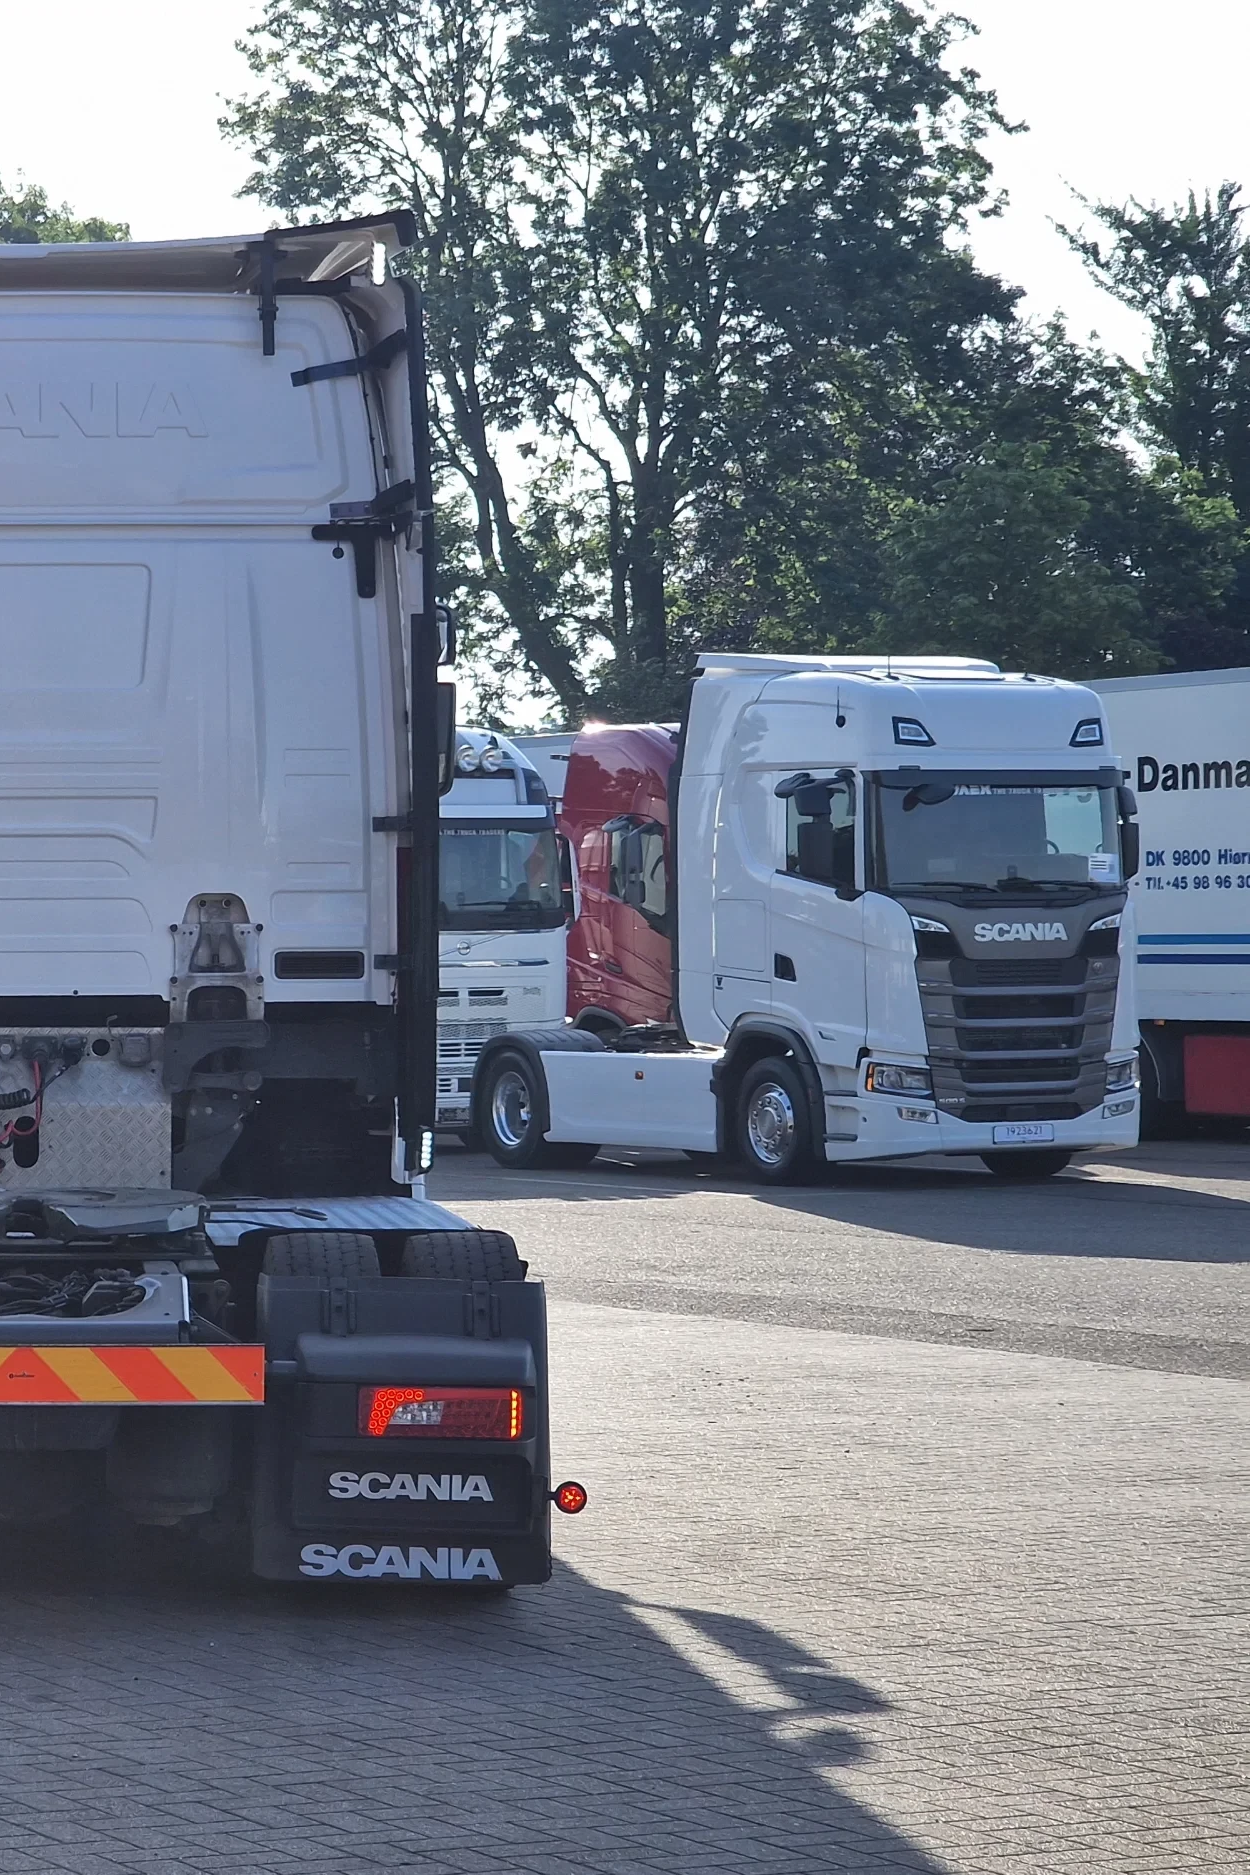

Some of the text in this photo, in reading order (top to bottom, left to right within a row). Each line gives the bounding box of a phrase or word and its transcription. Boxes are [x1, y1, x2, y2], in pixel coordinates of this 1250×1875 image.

[1145, 850, 1166, 867] DK
[1172, 849, 1211, 866] 9800
[1193, 875, 1210, 890] 98
[1215, 874, 1233, 889] 96
[973, 922, 1069, 942] SCANIA
[328, 1471, 494, 1502] SCANIA
[299, 1543, 504, 1581] SCANIA
